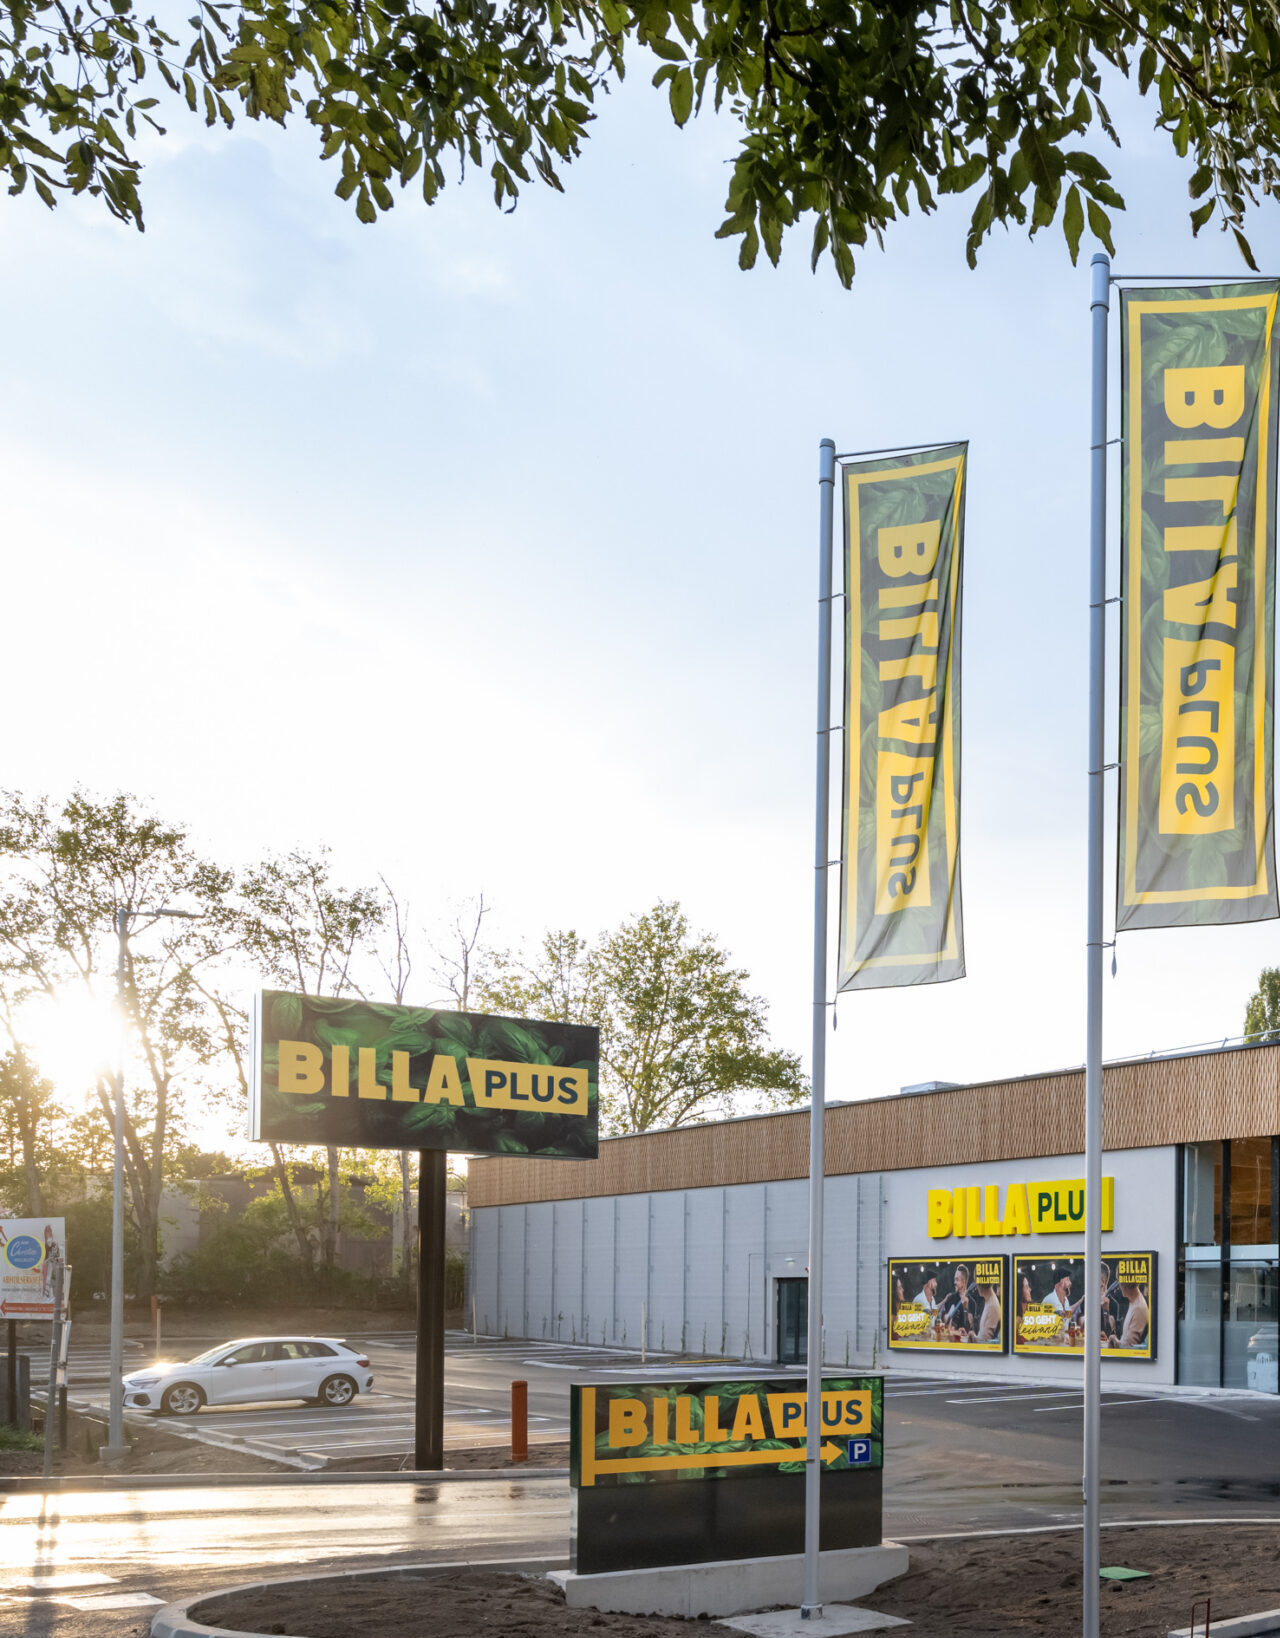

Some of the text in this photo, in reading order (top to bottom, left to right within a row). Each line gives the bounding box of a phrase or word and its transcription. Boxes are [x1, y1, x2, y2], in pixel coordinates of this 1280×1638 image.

[278, 1039, 579, 1106] BILLA PLUS
[928, 1183, 1088, 1239] BILLA PLU
[976, 1263, 999, 1276] BILLA
[1118, 1260, 1147, 1274] BILLA
[897, 1313, 907, 1323] SO
[1024, 1314, 1056, 1326] SO GEHT
[608, 1394, 766, 1448] BILLA
[853, 1444, 867, 1460] P
